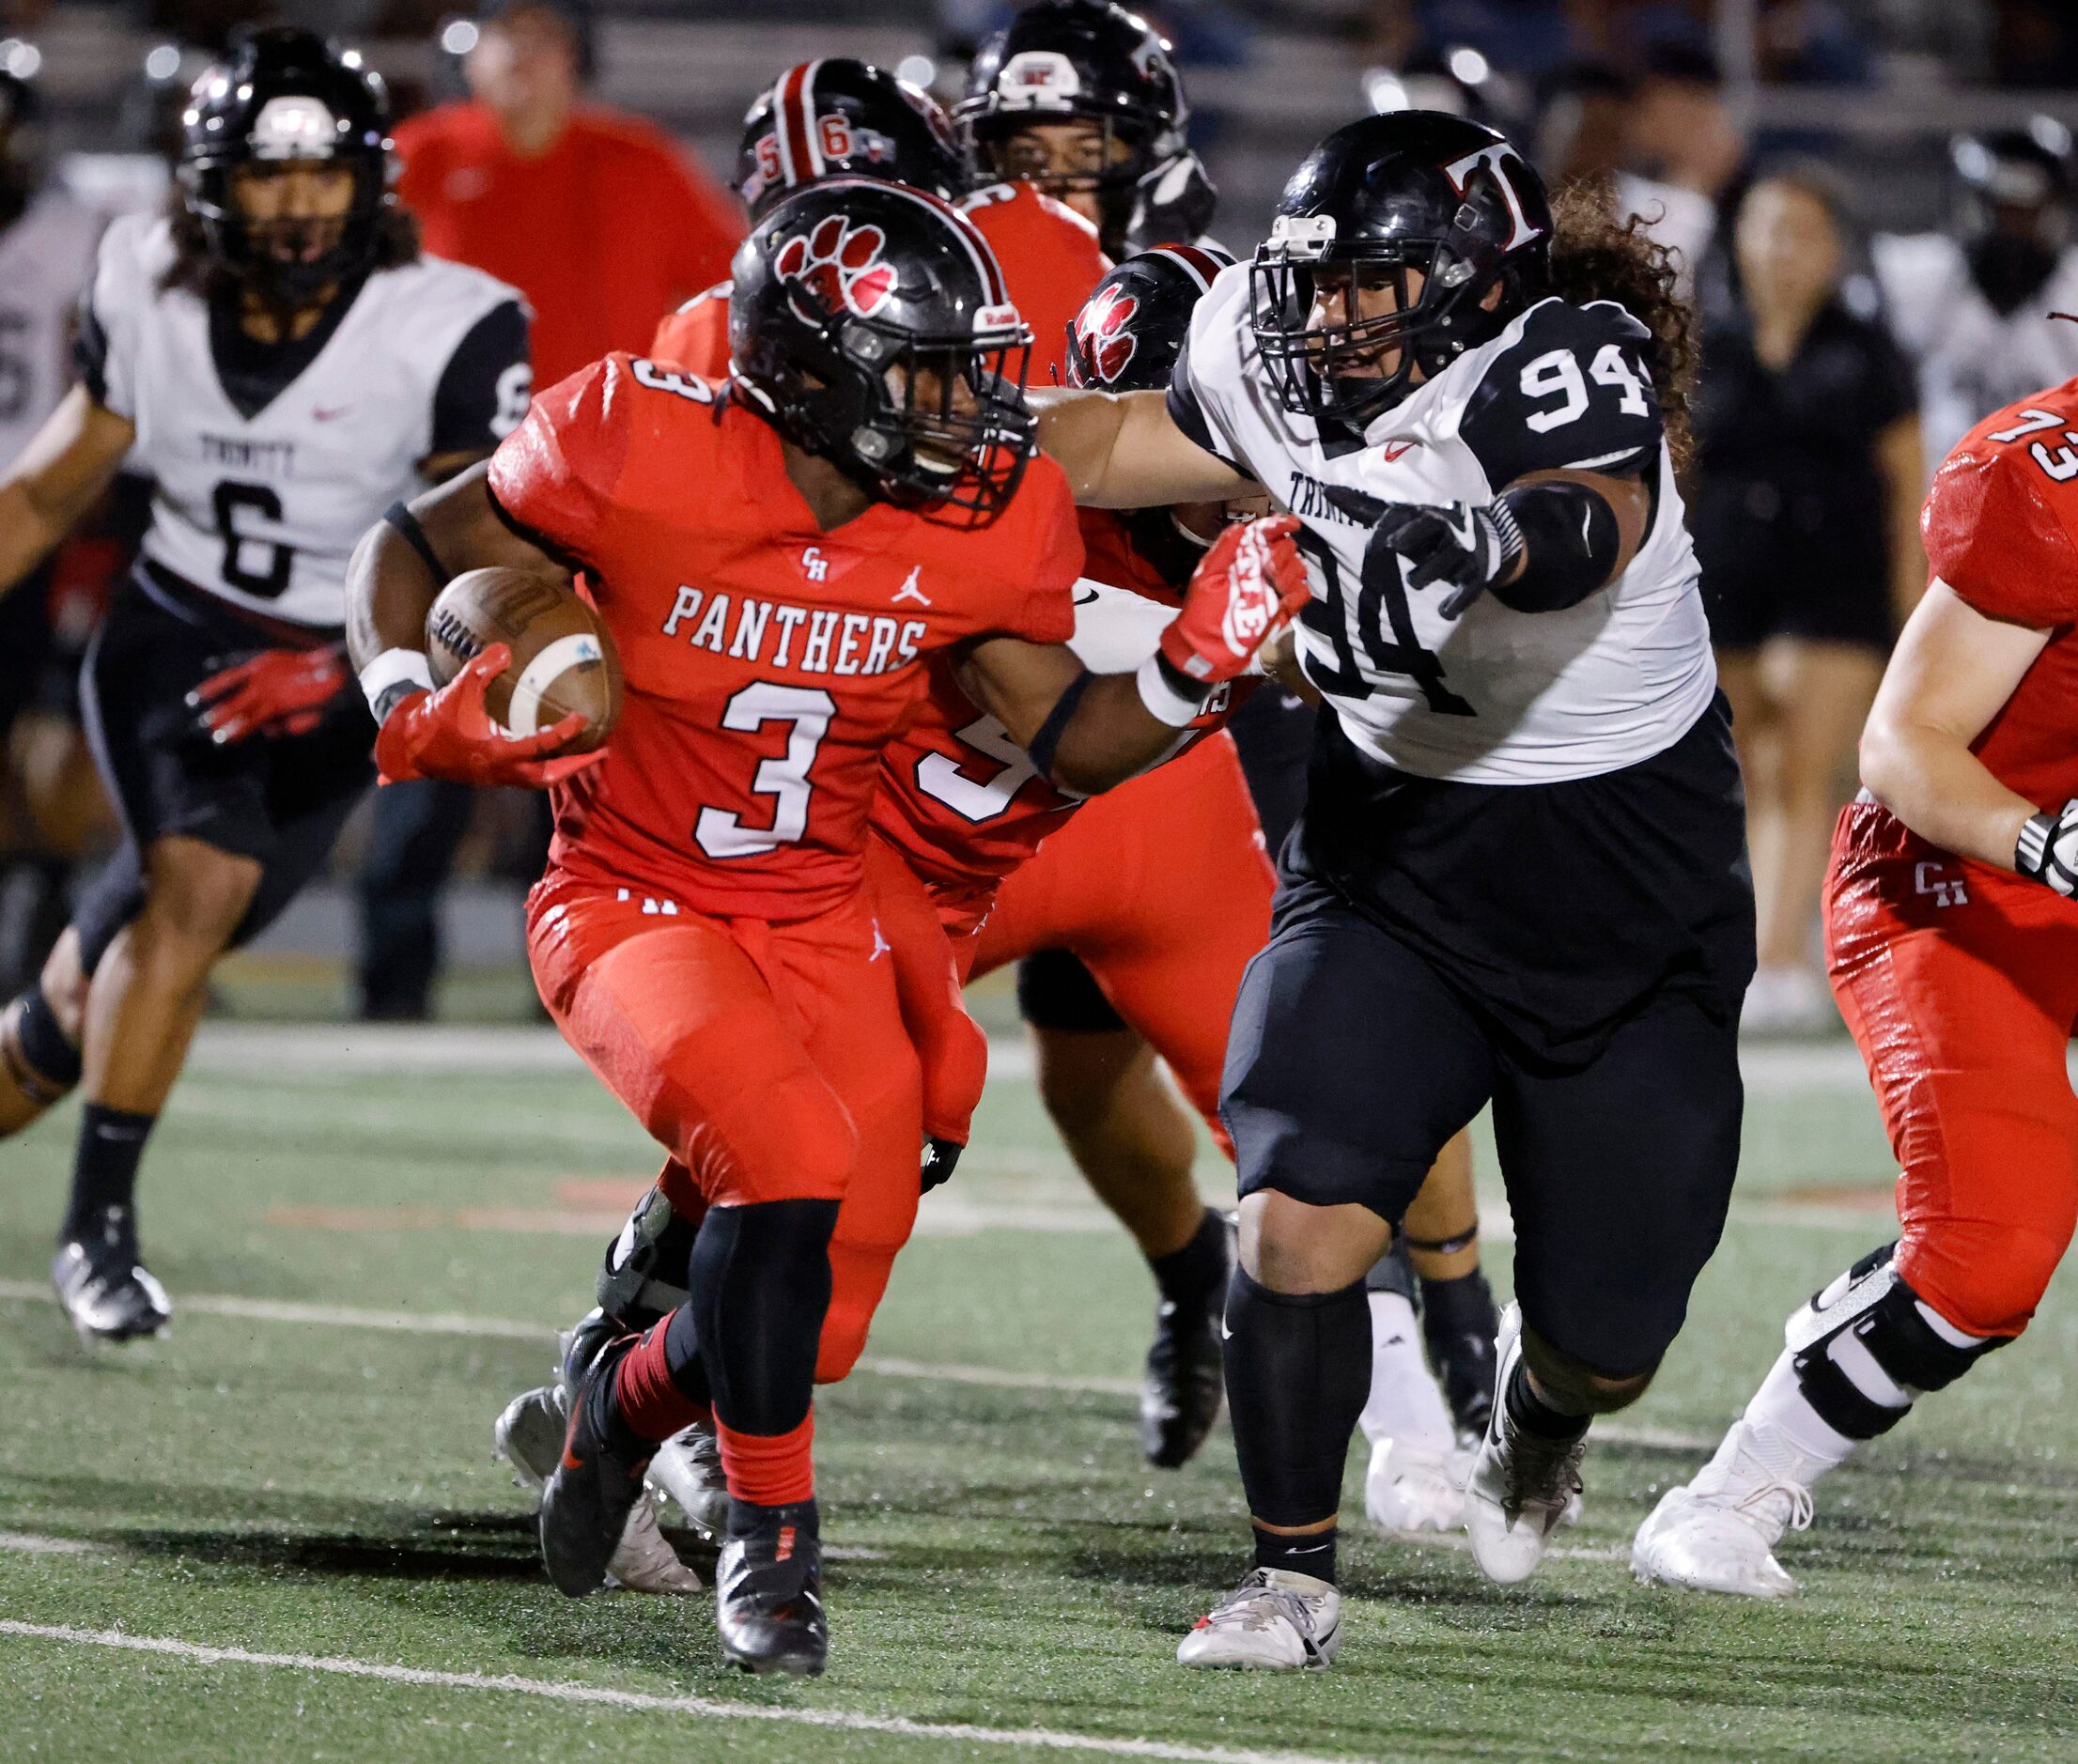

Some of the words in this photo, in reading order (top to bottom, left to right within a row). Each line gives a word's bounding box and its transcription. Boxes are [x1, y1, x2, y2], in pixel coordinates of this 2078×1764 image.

[1438, 141, 1543, 254] T
[631, 358, 713, 405] 3
[1519, 343, 1650, 434] 94
[212, 478, 295, 597] 6
[661, 584, 927, 675] PANTHERS
[692, 680, 838, 859] 3
